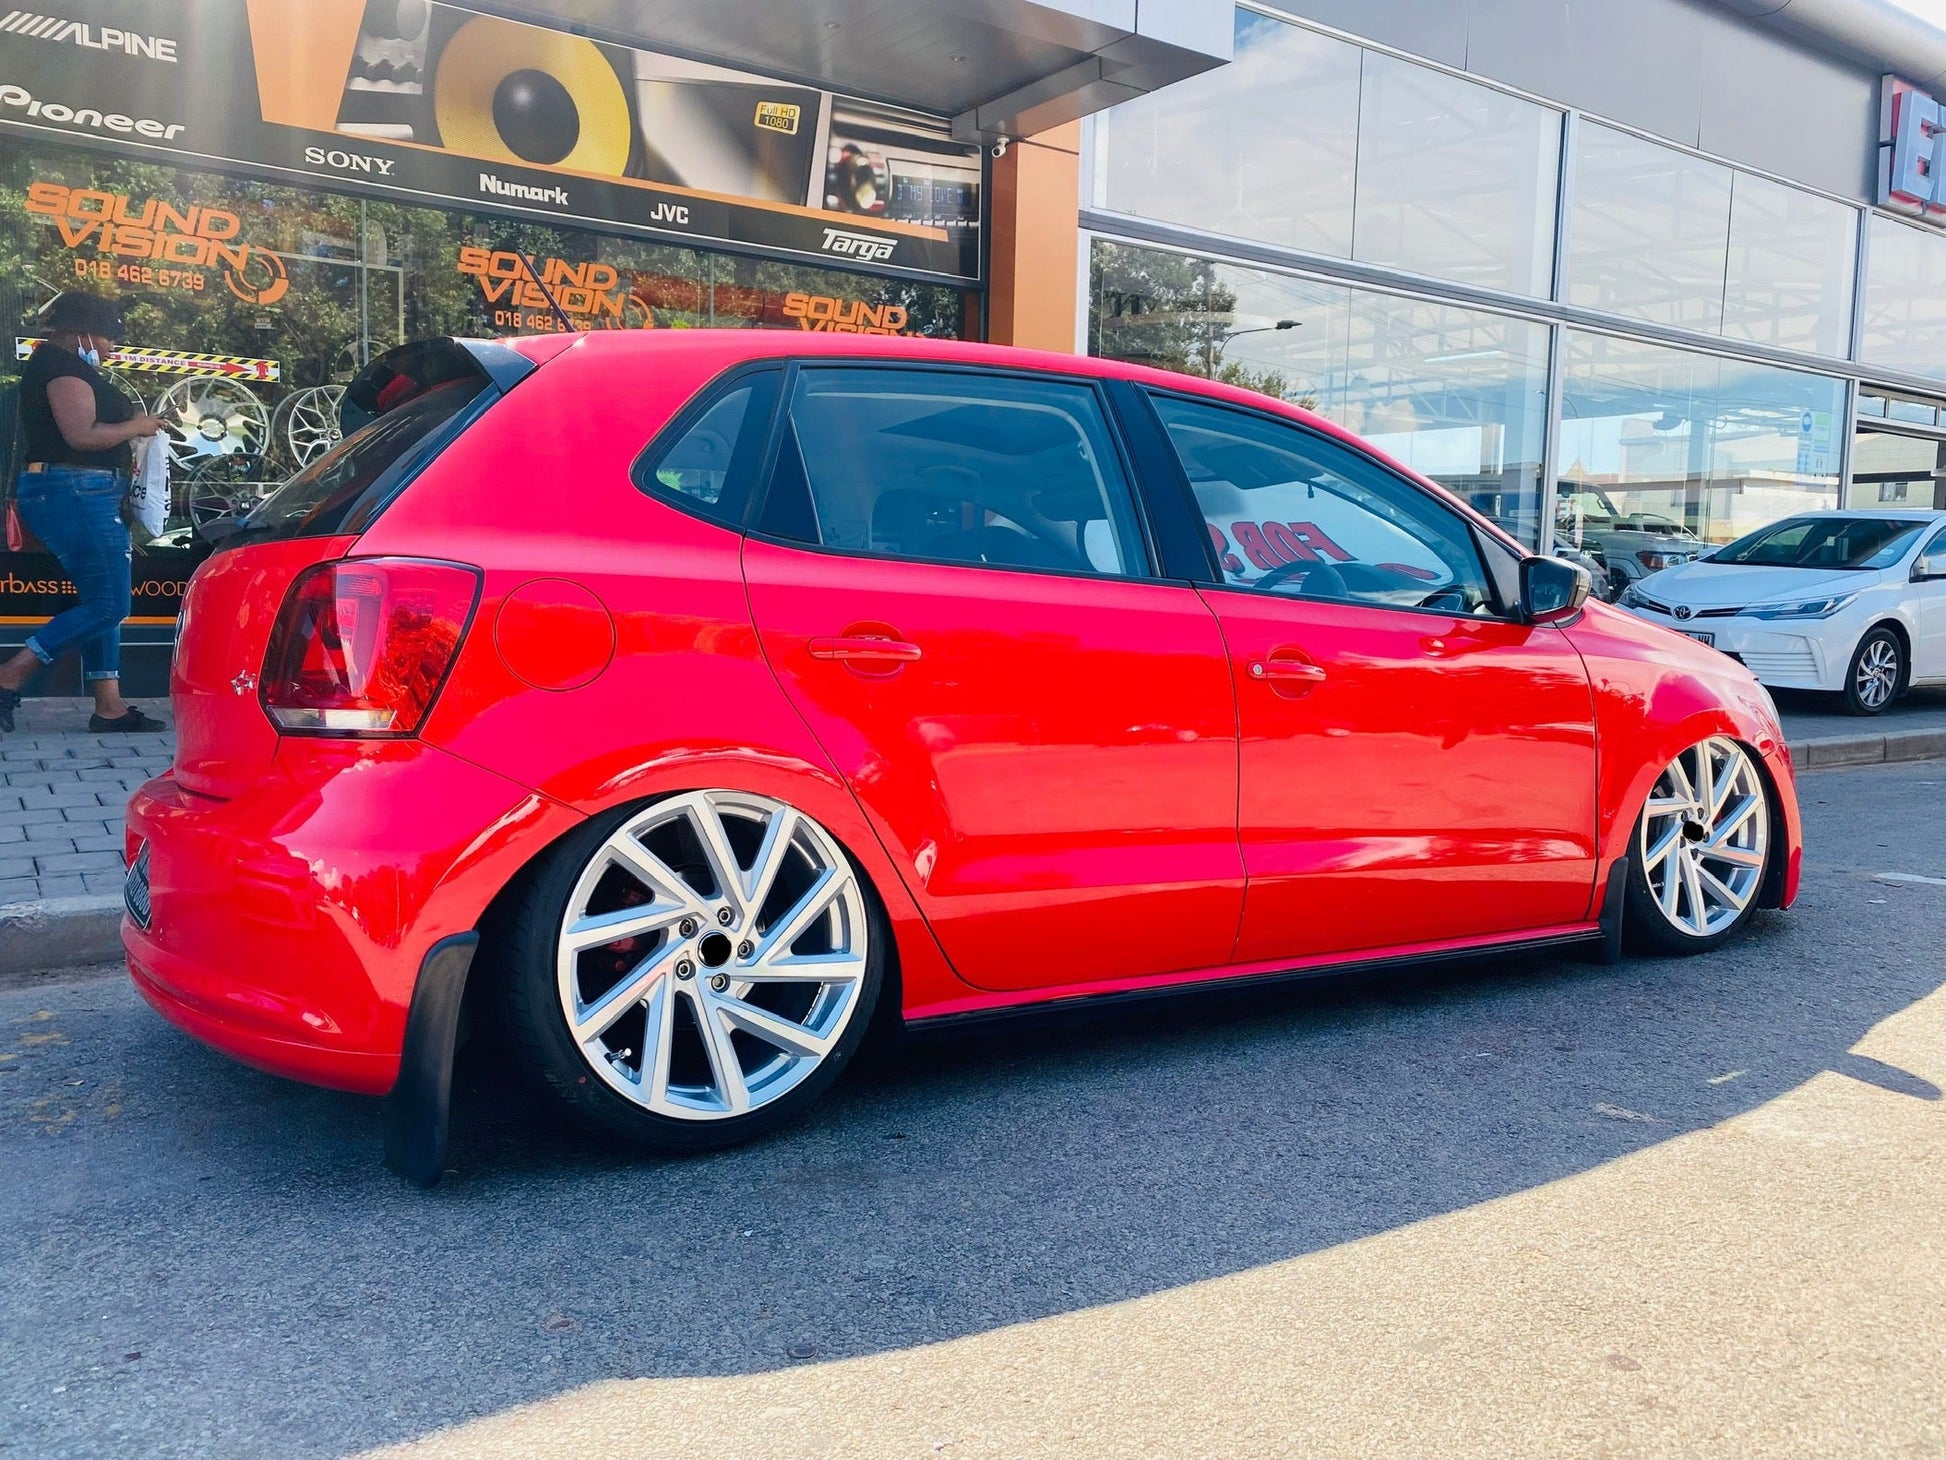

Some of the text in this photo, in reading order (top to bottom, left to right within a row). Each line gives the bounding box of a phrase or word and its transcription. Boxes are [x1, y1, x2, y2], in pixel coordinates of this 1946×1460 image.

[52, 22, 177, 62] ALPINE
[0, 84, 185, 140] Pioneer
[760, 104, 796, 118] Full HD
[764, 115, 789, 129] 1080
[305, 147, 395, 176] SONY
[479, 173, 568, 205] Numark
[25, 181, 241, 240] SOUND
[650, 202, 689, 225] JVC
[54, 214, 251, 271] VISION
[821, 228, 898, 261] Targa
[75, 258, 205, 291] 018 462 6739
[457, 246, 618, 291] SOUND
[479, 274, 626, 318] VISION
[782, 291, 908, 330] SOUND
[494, 310, 523, 327] 018
[526, 314, 553, 331] 462
[139, 356, 187, 366] DISTANCE
